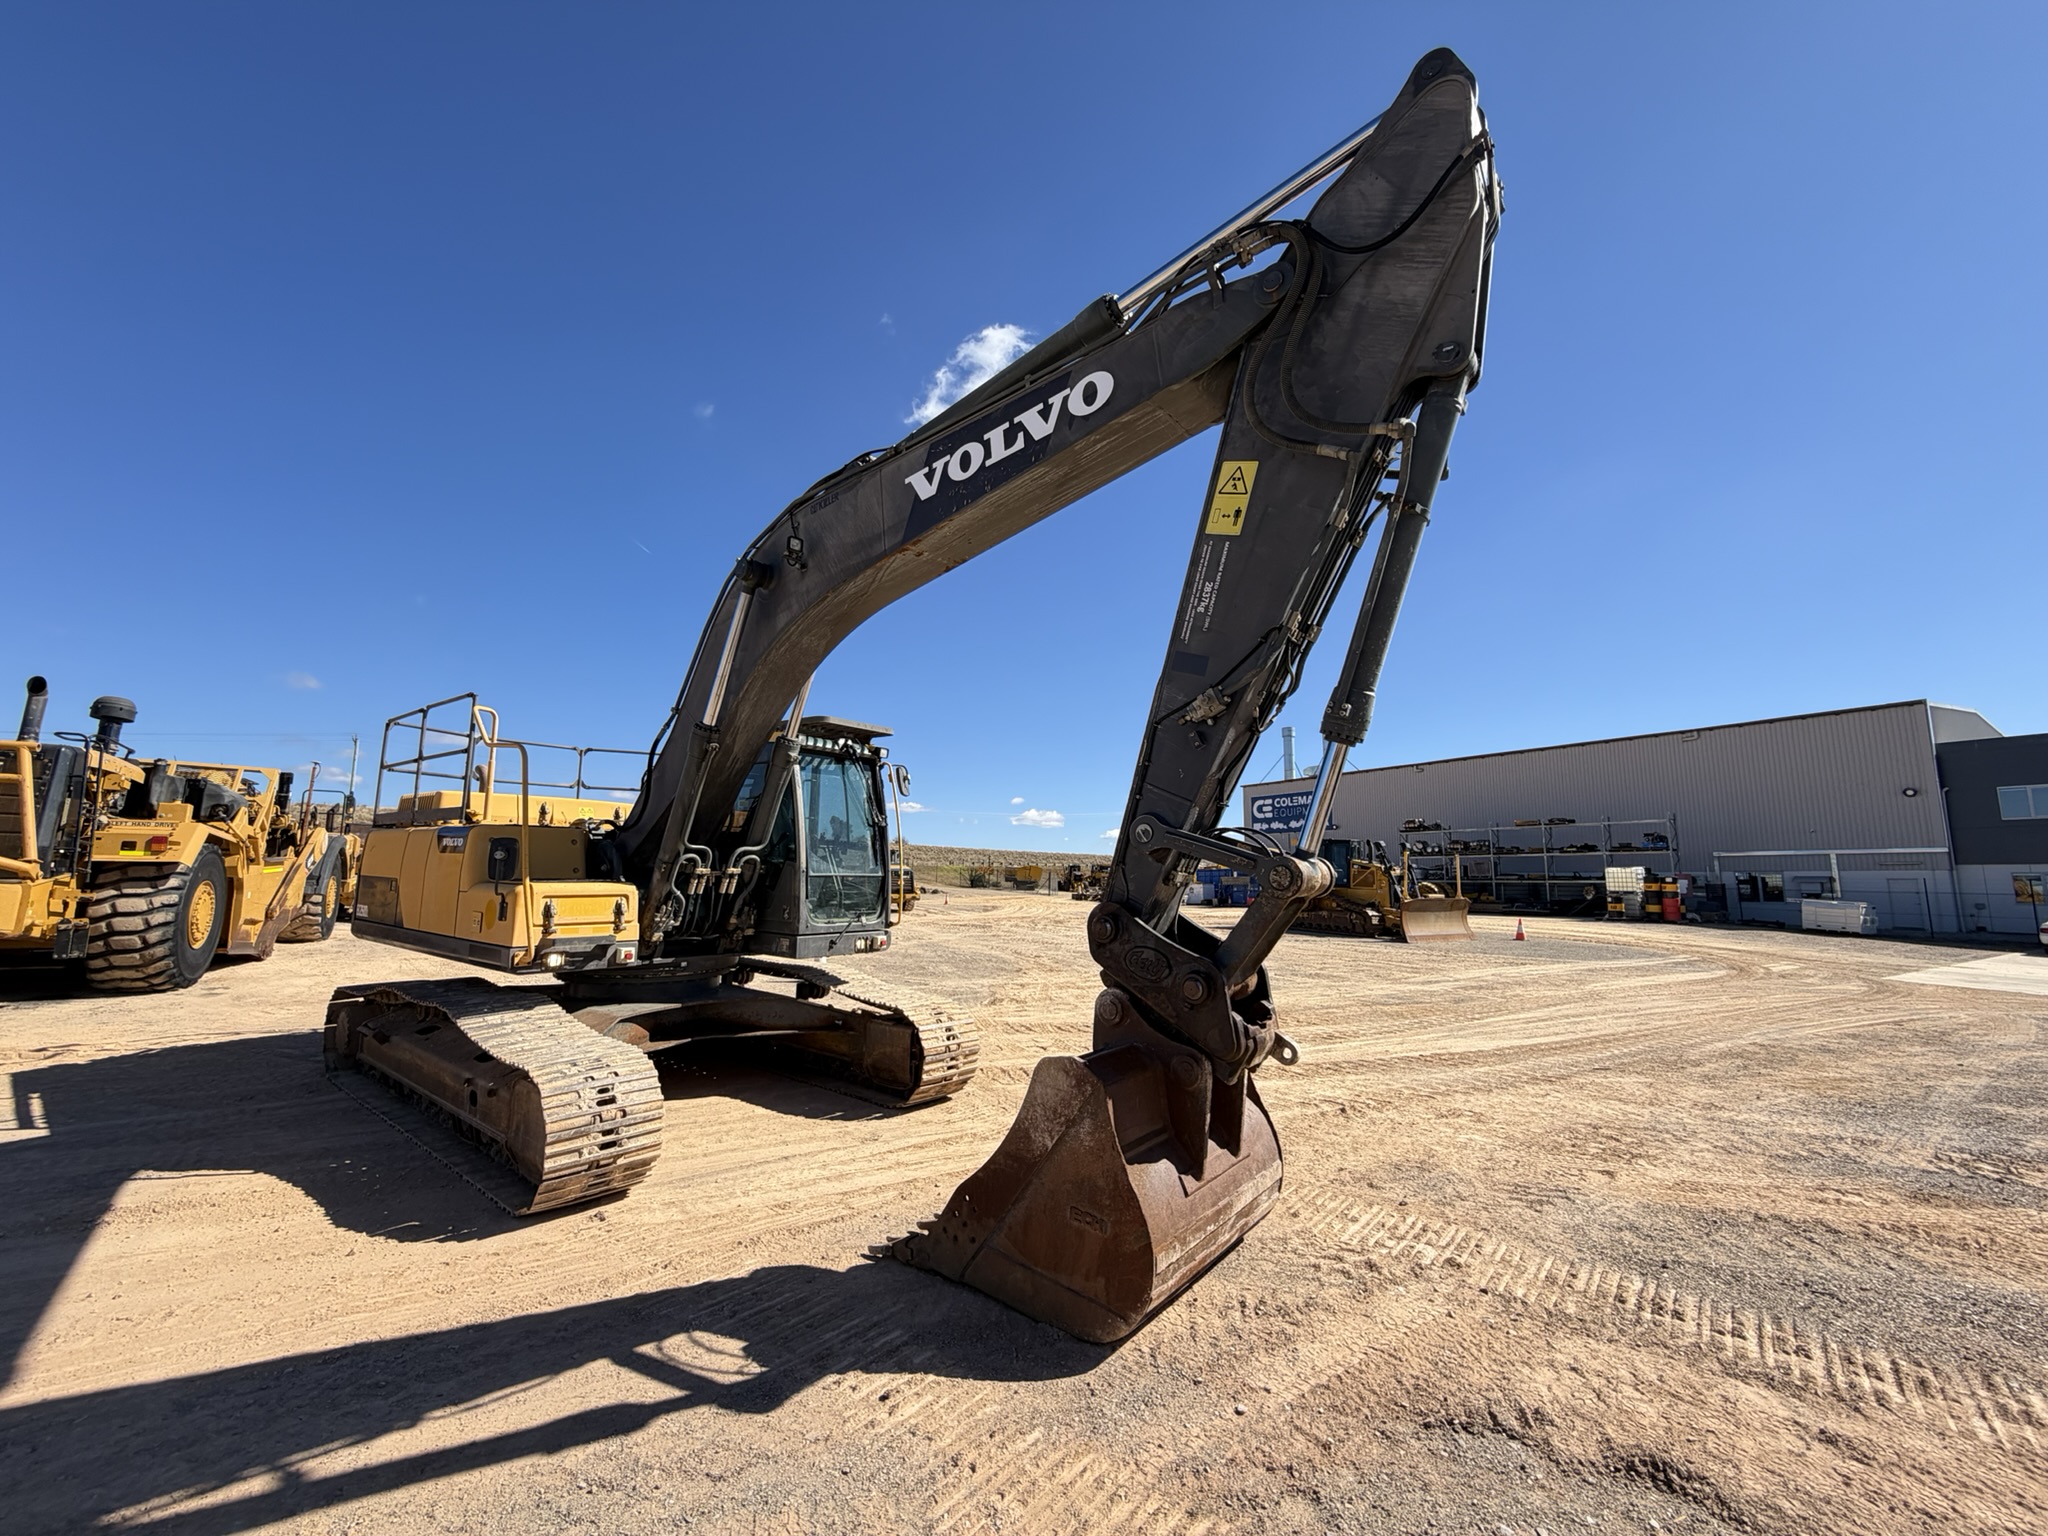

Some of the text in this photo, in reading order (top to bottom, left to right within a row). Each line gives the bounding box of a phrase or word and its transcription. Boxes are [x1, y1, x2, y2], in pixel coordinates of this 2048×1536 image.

[905, 371, 1115, 501] VOLVO
[1219, 541, 1230, 572] MAXIMUM
[1197, 581, 1214, 614] 2837kg
[1207, 590, 1217, 616] CAPACITY
[1274, 796, 1313, 807] COLEMA
